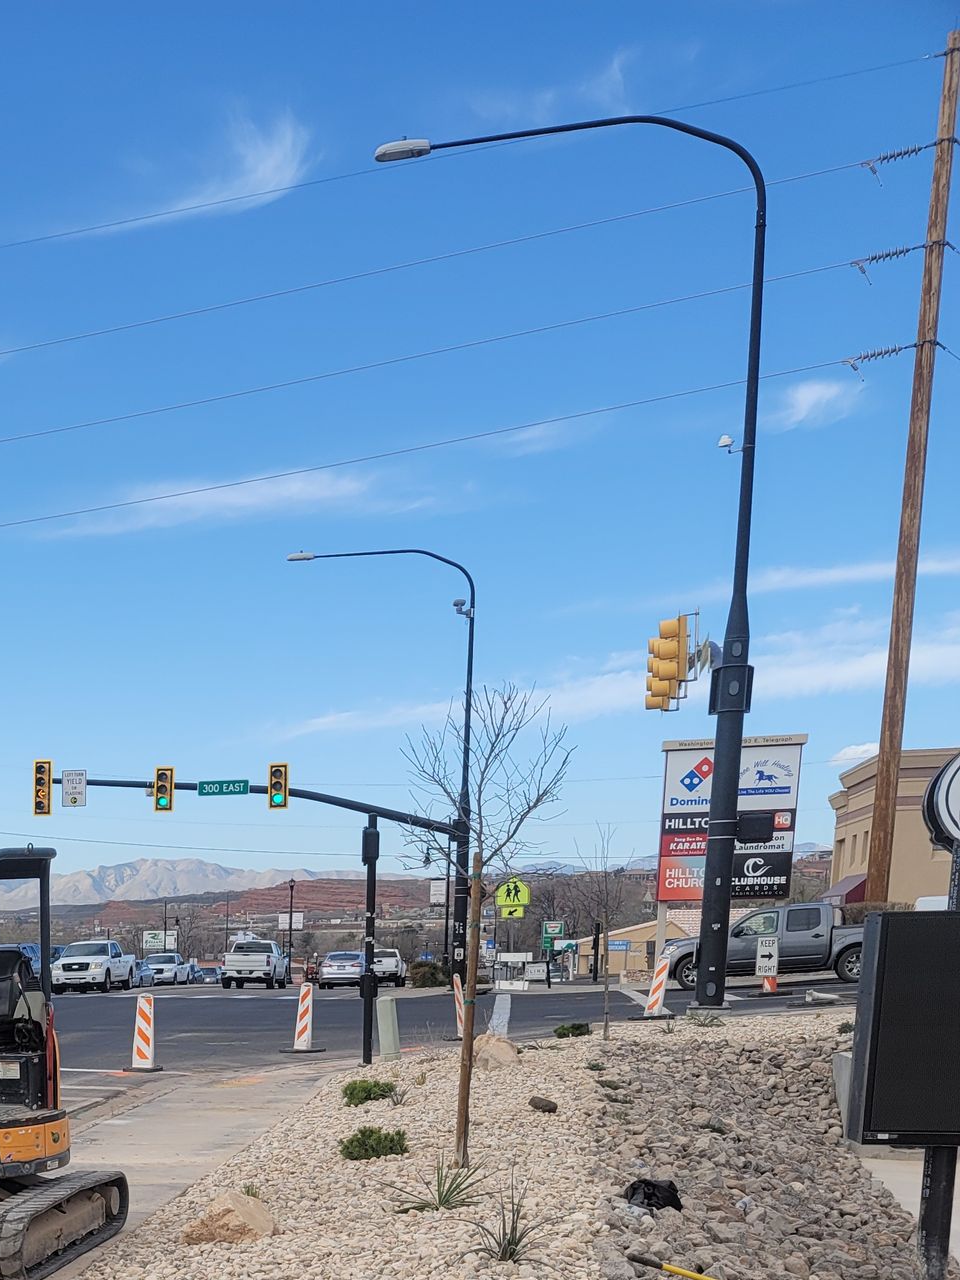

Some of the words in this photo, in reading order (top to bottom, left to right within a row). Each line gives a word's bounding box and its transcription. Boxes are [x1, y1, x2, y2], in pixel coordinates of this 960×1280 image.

[202, 783, 219, 793] 300
[222, 782, 244, 792] EAST
[775, 816, 790, 825] HQ
[669, 842, 707, 850] KARATE
[760, 940, 776, 948] KEEP
[757, 965, 776, 974] RIGHT
